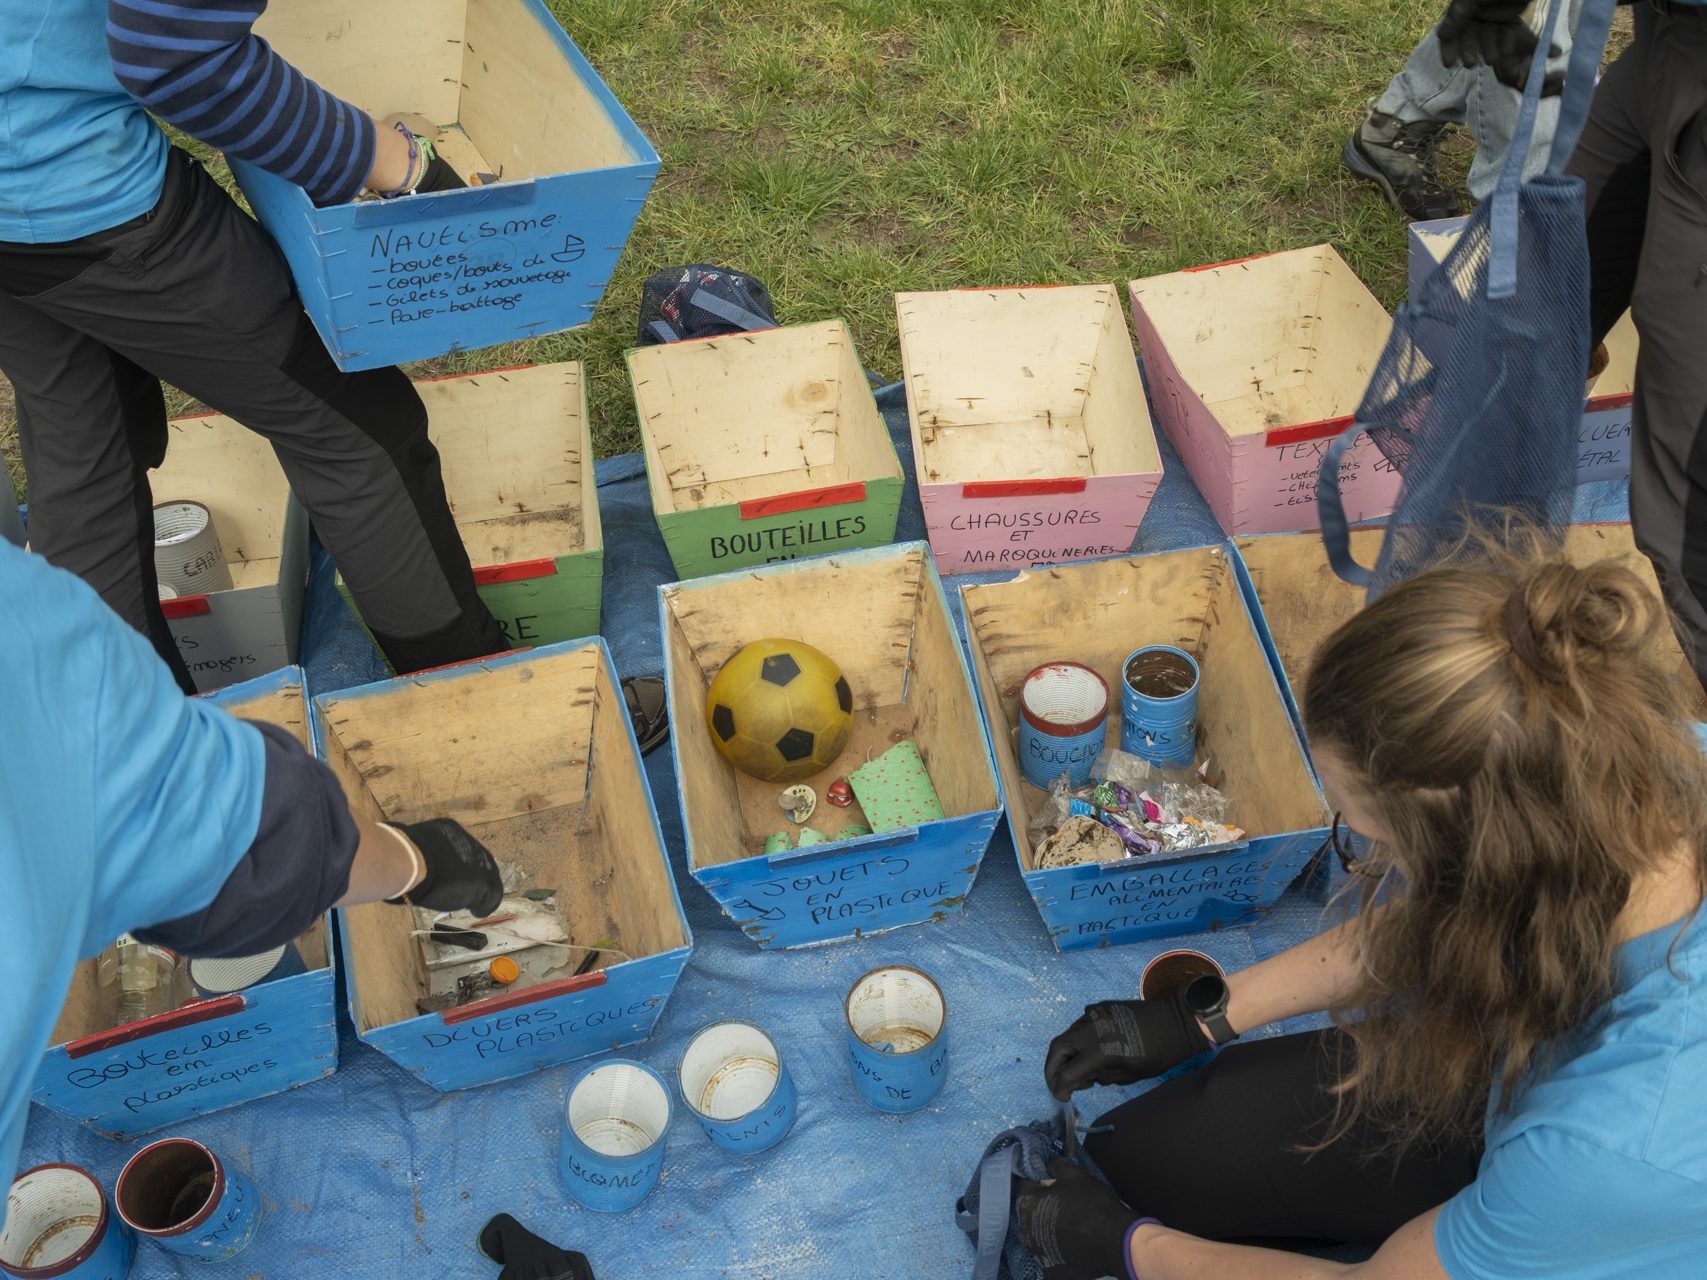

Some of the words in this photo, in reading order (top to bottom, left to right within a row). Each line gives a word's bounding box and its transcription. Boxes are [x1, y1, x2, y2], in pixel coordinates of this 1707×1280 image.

[1575, 449, 1621, 468] ÉTAL
[950, 509, 1101, 531] CHAUSSURES
[1009, 530, 1035, 542] ET
[752, 855, 910, 897] JOUETS
[1070, 861, 1273, 901] EMBALLAGES
[805, 886, 845, 906] EN
[1140, 898, 1178, 912] EN
[67, 1021, 273, 1089] Bouteilles
[166, 1058, 213, 1077] en
[122, 1058, 279, 1115] plastiques
[885, 1085, 913, 1100] DE
